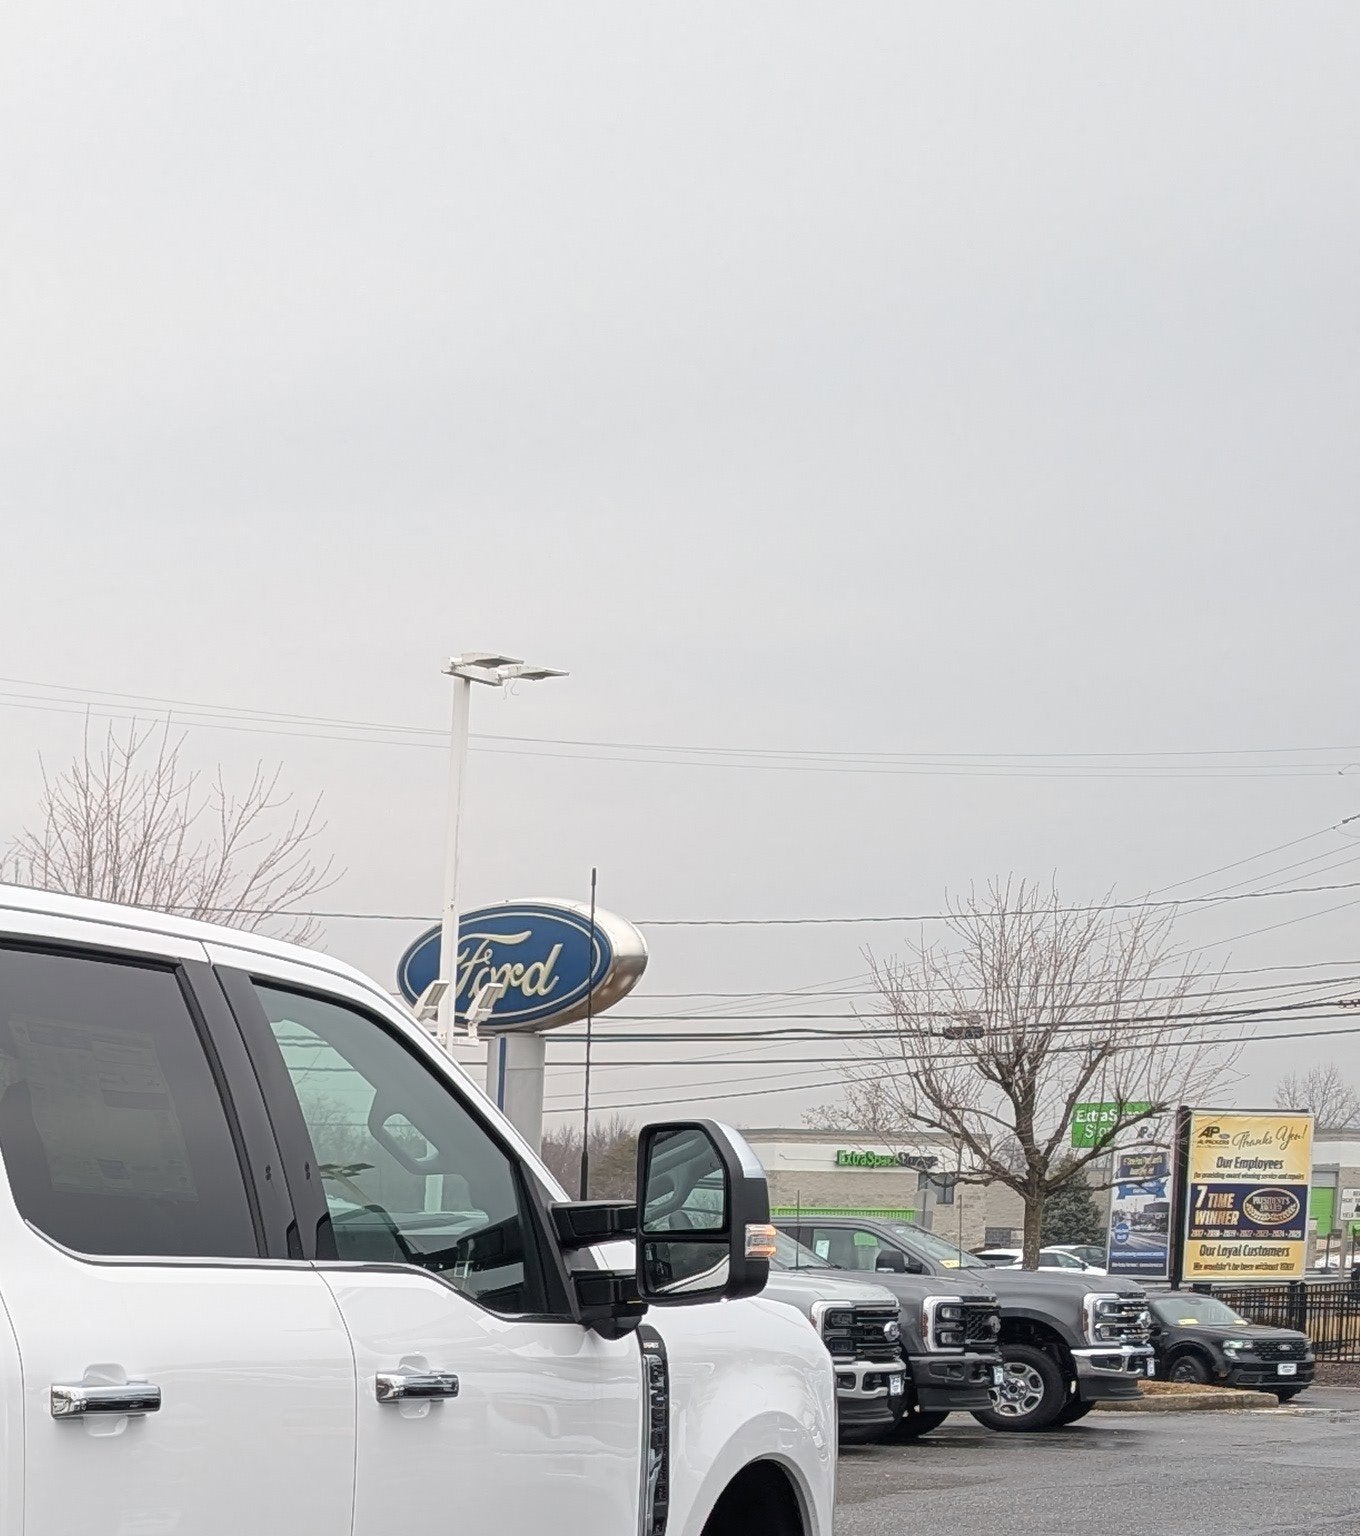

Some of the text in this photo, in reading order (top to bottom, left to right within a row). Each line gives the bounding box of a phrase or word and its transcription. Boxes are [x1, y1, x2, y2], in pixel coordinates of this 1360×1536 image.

[453, 930, 563, 999] Ford
[1198, 1126, 1220, 1138] AP
[1216, 1157, 1284, 1171] Our Employees
[1195, 1186, 1235, 1208] 7 TIME
[1195, 1210, 1239, 1225] WINNER
[1200, 1245, 1290, 1258] Our Loyal Customers
